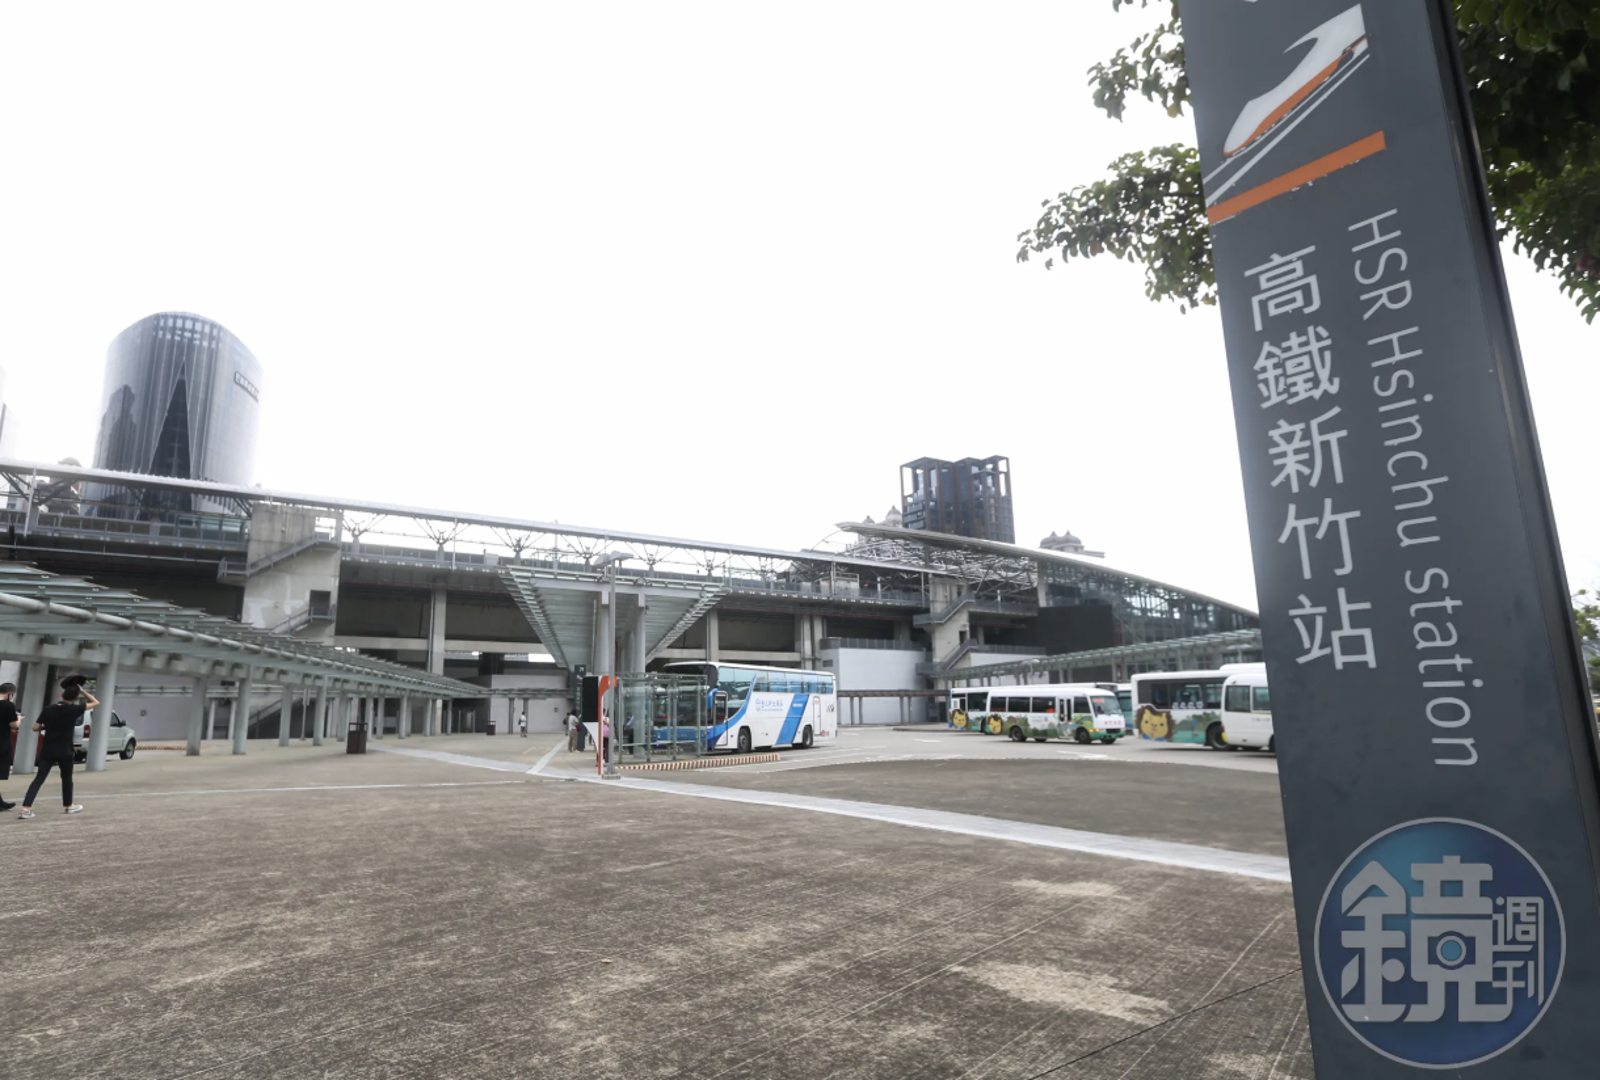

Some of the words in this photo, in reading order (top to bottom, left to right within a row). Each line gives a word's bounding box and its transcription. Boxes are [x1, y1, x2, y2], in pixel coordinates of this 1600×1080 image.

[1348, 208, 1413, 321] HSR
[1244, 245, 1377, 670] 高鐵新竹站
[1367, 326, 1449, 548] Hsinchu
[1405, 567, 1484, 766] station
